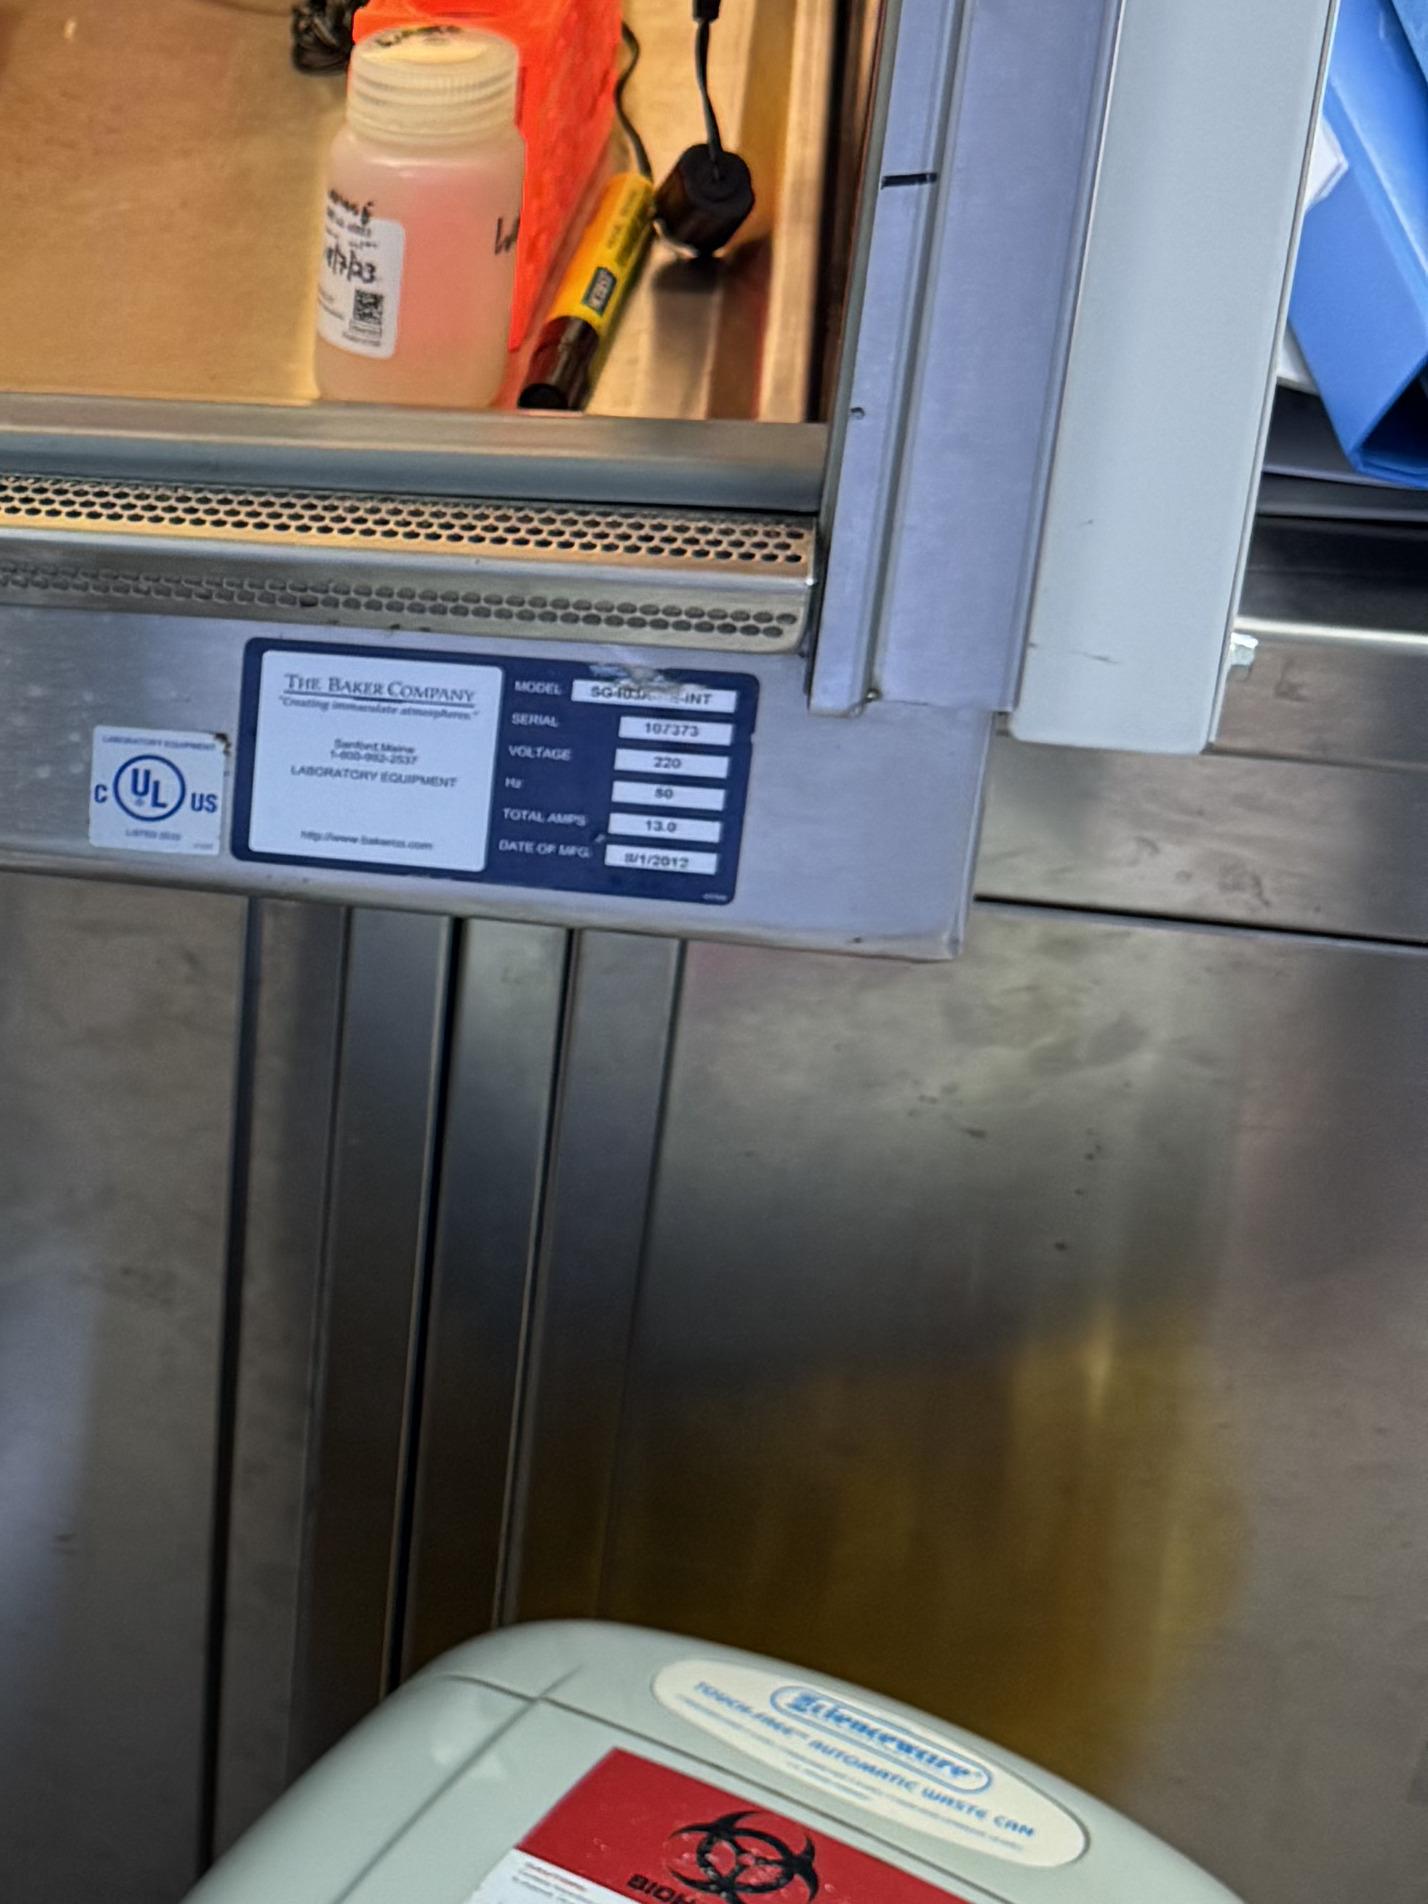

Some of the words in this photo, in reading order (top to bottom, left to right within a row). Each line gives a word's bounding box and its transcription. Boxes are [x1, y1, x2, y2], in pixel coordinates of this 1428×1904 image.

[283, 673, 321, 691] THE
[328, 677, 385, 696] BAKER
[387, 681, 476, 703] COMPANY
[514, 680, 562, 696] MODEL
[510, 712, 560, 729] SERIAL
[508, 745, 573, 762] VOLTAGE
[653, 756, 683, 770] 220
[130, 767, 169, 809] UL
[290, 764, 379, 782] LABORATORY
[380, 772, 460, 789] EQUIPMENT
[504, 777, 524, 790] Hz
[190, 792, 219, 814] US
[502, 807, 545, 824] TOTAL
[546, 812, 588, 828] AMPS
[645, 820, 678, 834] 13.0
[498, 839, 535, 854] DATE
[535, 843, 556, 856] OF
[809, 1738, 919, 1793] AUTOMATIC
[921, 1786, 988, 1821] WASTE
[993, 1813, 1035, 1839] CAN
